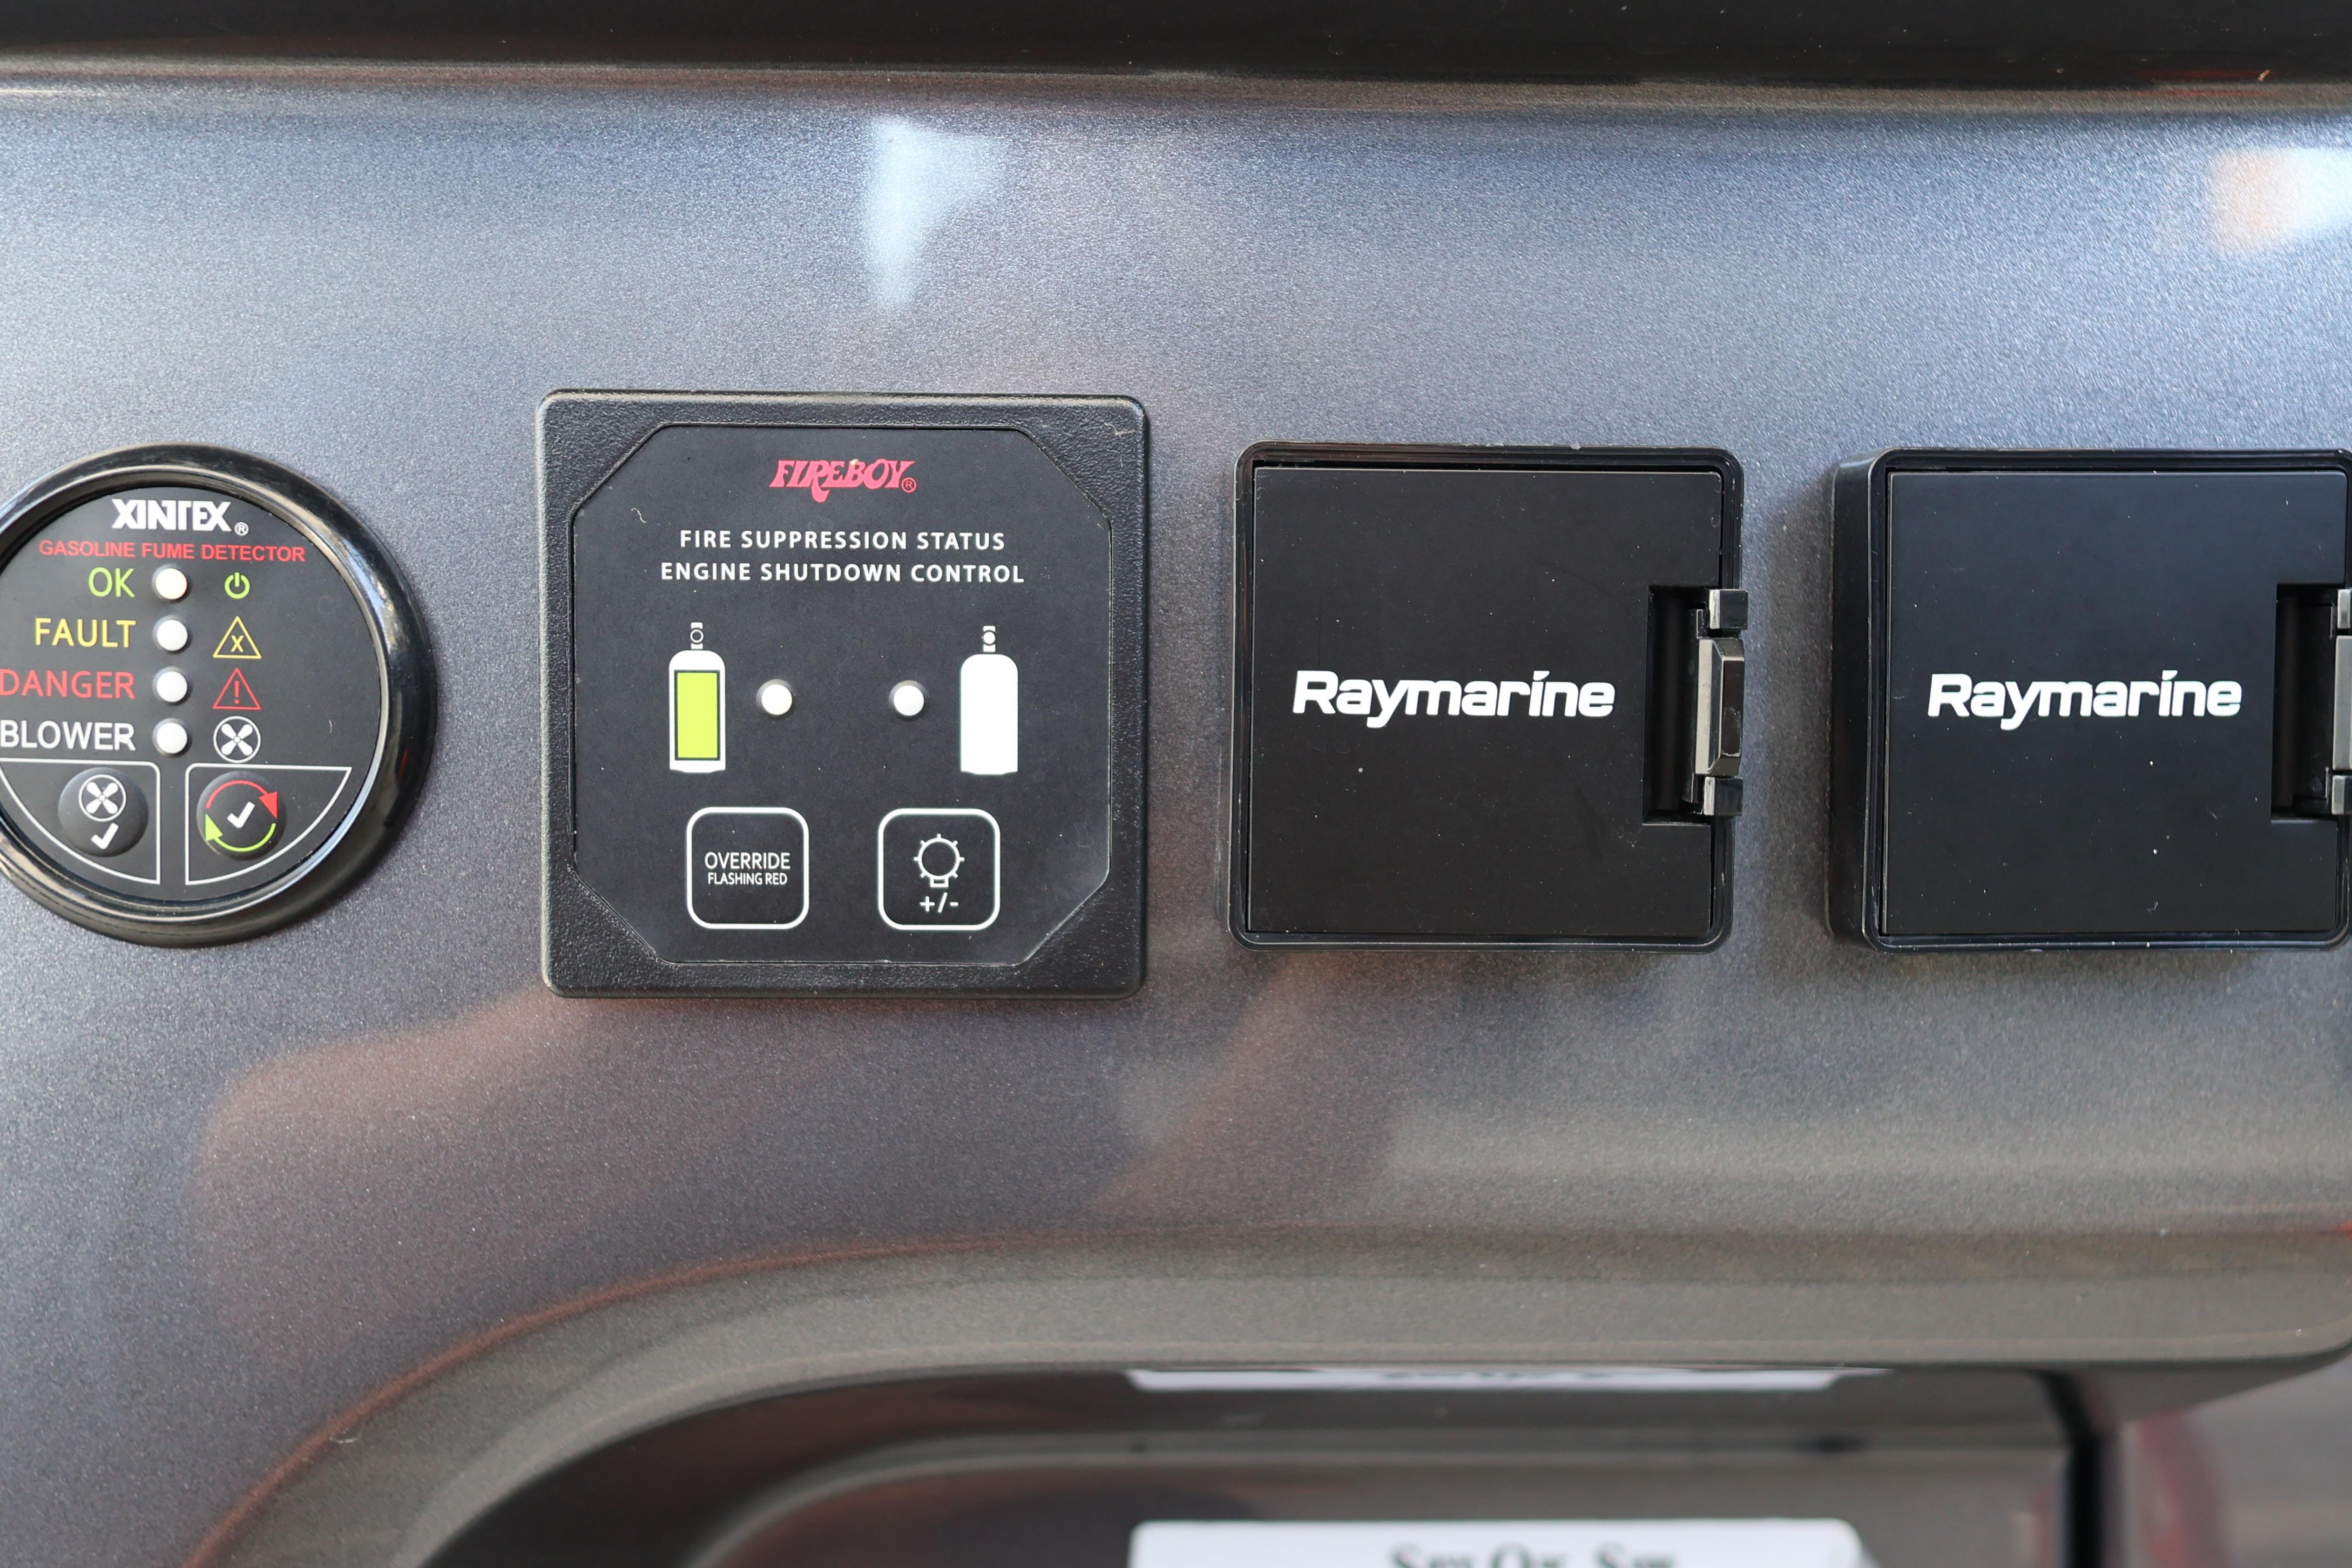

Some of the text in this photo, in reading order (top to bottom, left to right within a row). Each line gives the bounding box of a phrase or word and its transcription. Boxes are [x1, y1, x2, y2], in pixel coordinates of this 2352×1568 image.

[39, 540, 305, 562] GASOLINE FUME DETECTOR
[680, 530, 1005, 551] FIRE SUPPRESSION STATUS
[88, 567, 135, 598] OK
[661, 562, 1024, 583] ENGINE SHUTDOWN CONTROL
[35, 618, 136, 648] FAULT
[0, 669, 135, 699] DANGER
[1292, 670, 1615, 728] Raymarine
[1927, 670, 2242, 730] Raymarine
[0, 719, 136, 751] BLOWER
[704, 852, 791, 870] OVERRIDE
[708, 872, 788, 885] FLASHING RED
